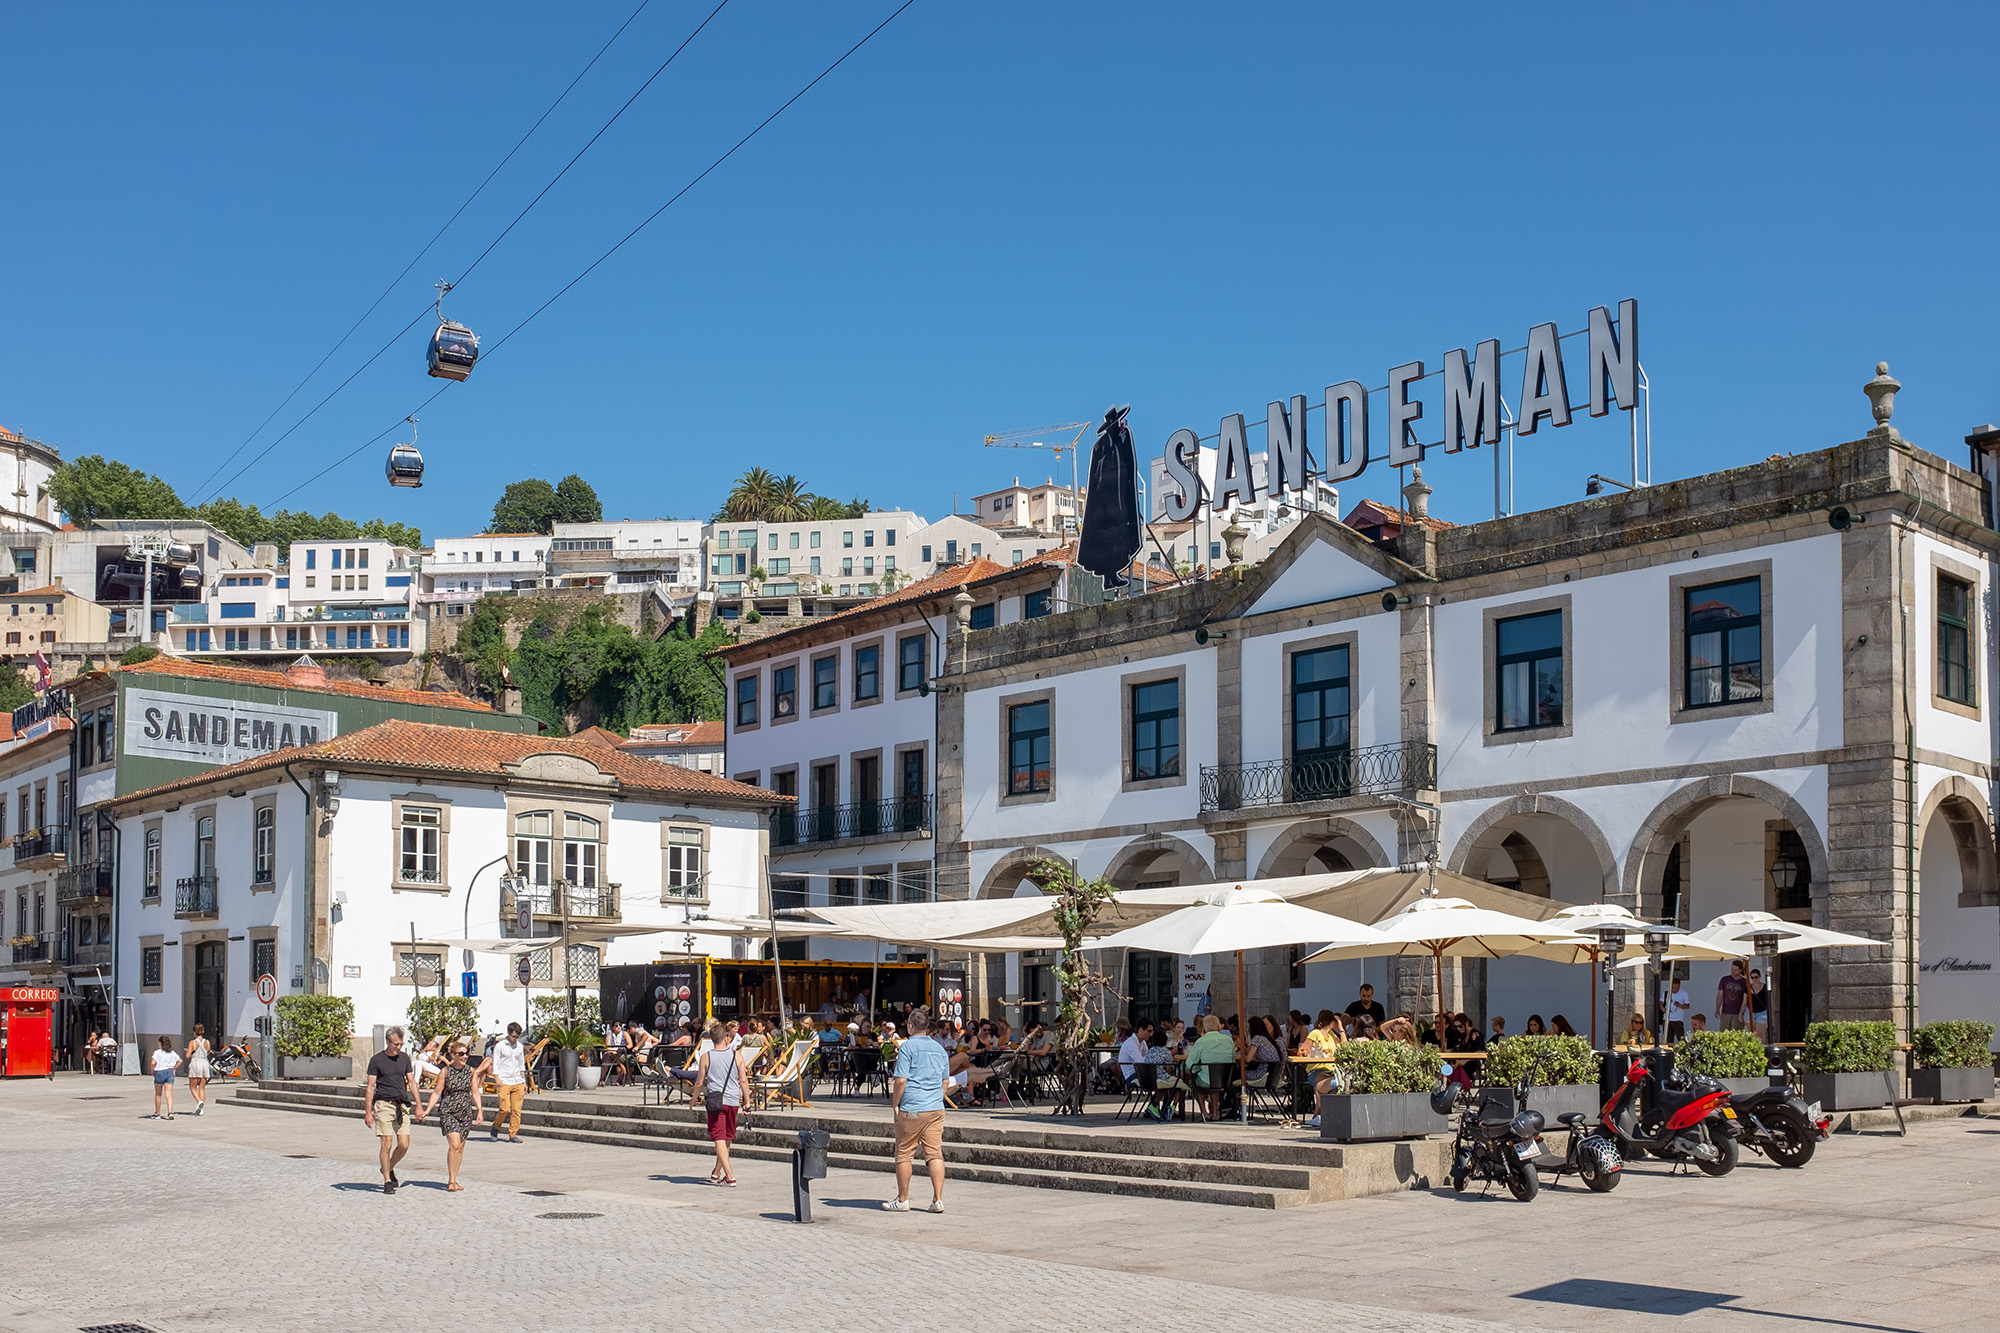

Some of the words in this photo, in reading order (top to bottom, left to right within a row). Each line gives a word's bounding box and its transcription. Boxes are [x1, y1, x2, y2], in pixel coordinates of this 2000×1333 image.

[1164, 298, 1639, 522] SANDEMAN
[144, 707, 320, 751] SANDEMAN
[1931, 959, 1944, 973] of
[1942, 957, 1992, 972] Sandeman
[1184, 973, 1206, 981] HOUSE
[12, 988, 57, 1000] CORREIOS
